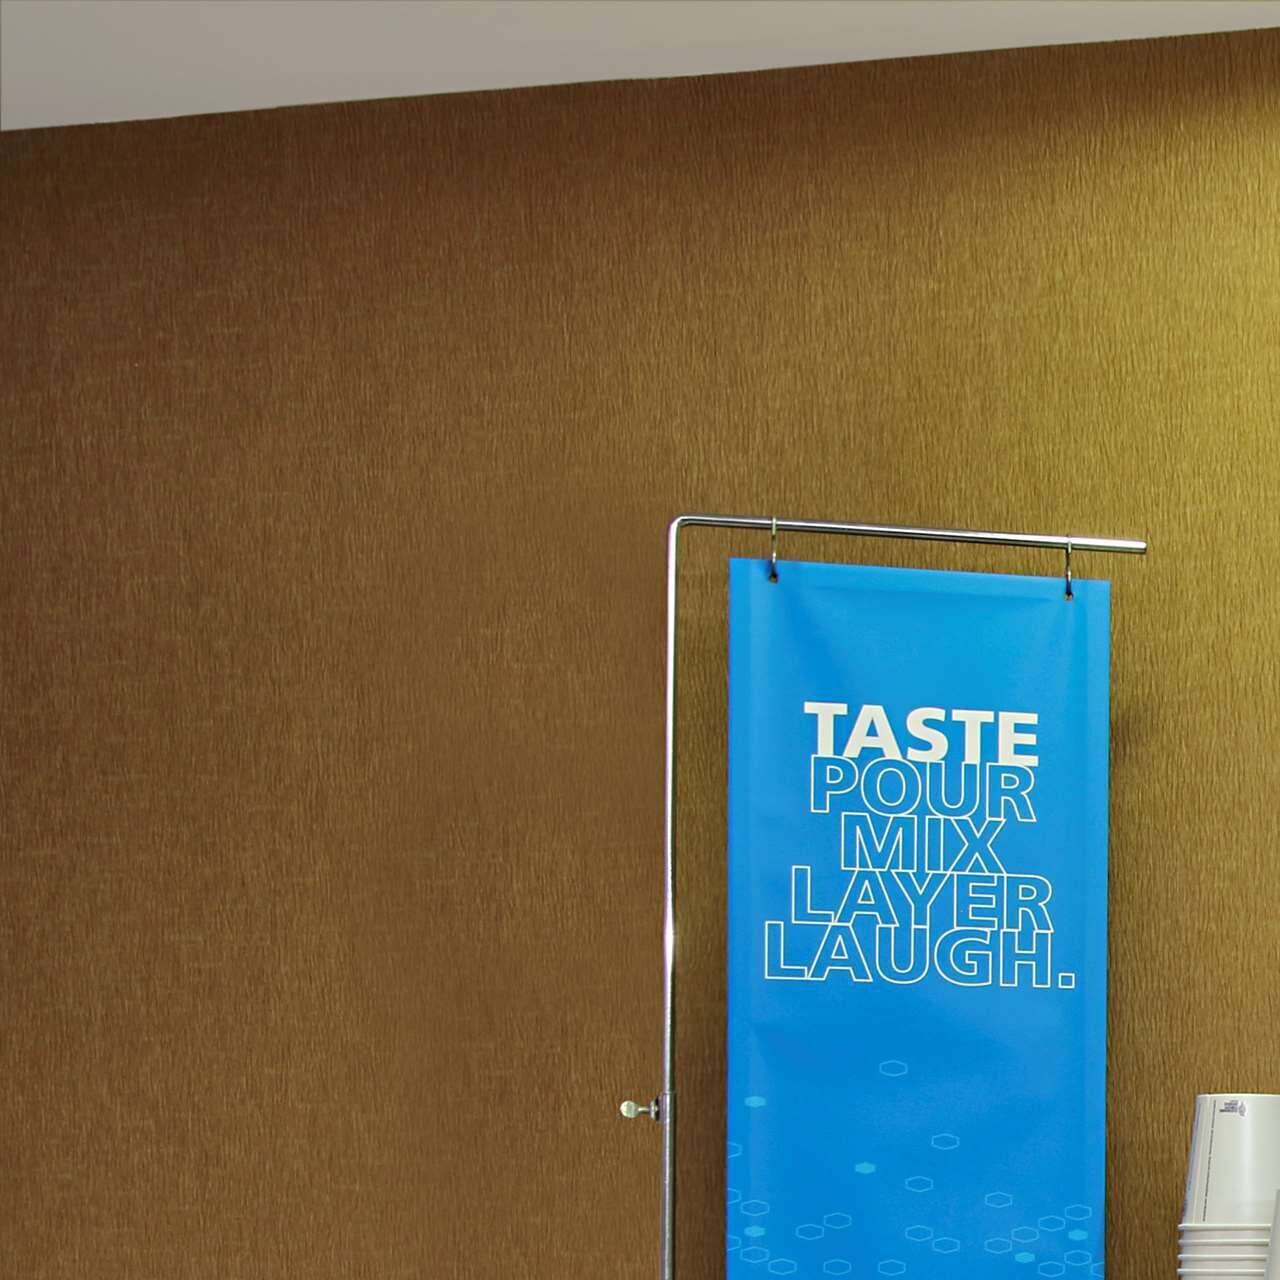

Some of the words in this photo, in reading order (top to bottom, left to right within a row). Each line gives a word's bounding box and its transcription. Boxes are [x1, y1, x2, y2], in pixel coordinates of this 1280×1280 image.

[803, 701, 1039, 767] TASTE
[810, 754, 1037, 822] POUR
[841, 812, 1007, 876] MIX
[791, 865, 1054, 933] LAYER
[764, 920, 1076, 989] LAUGH.
